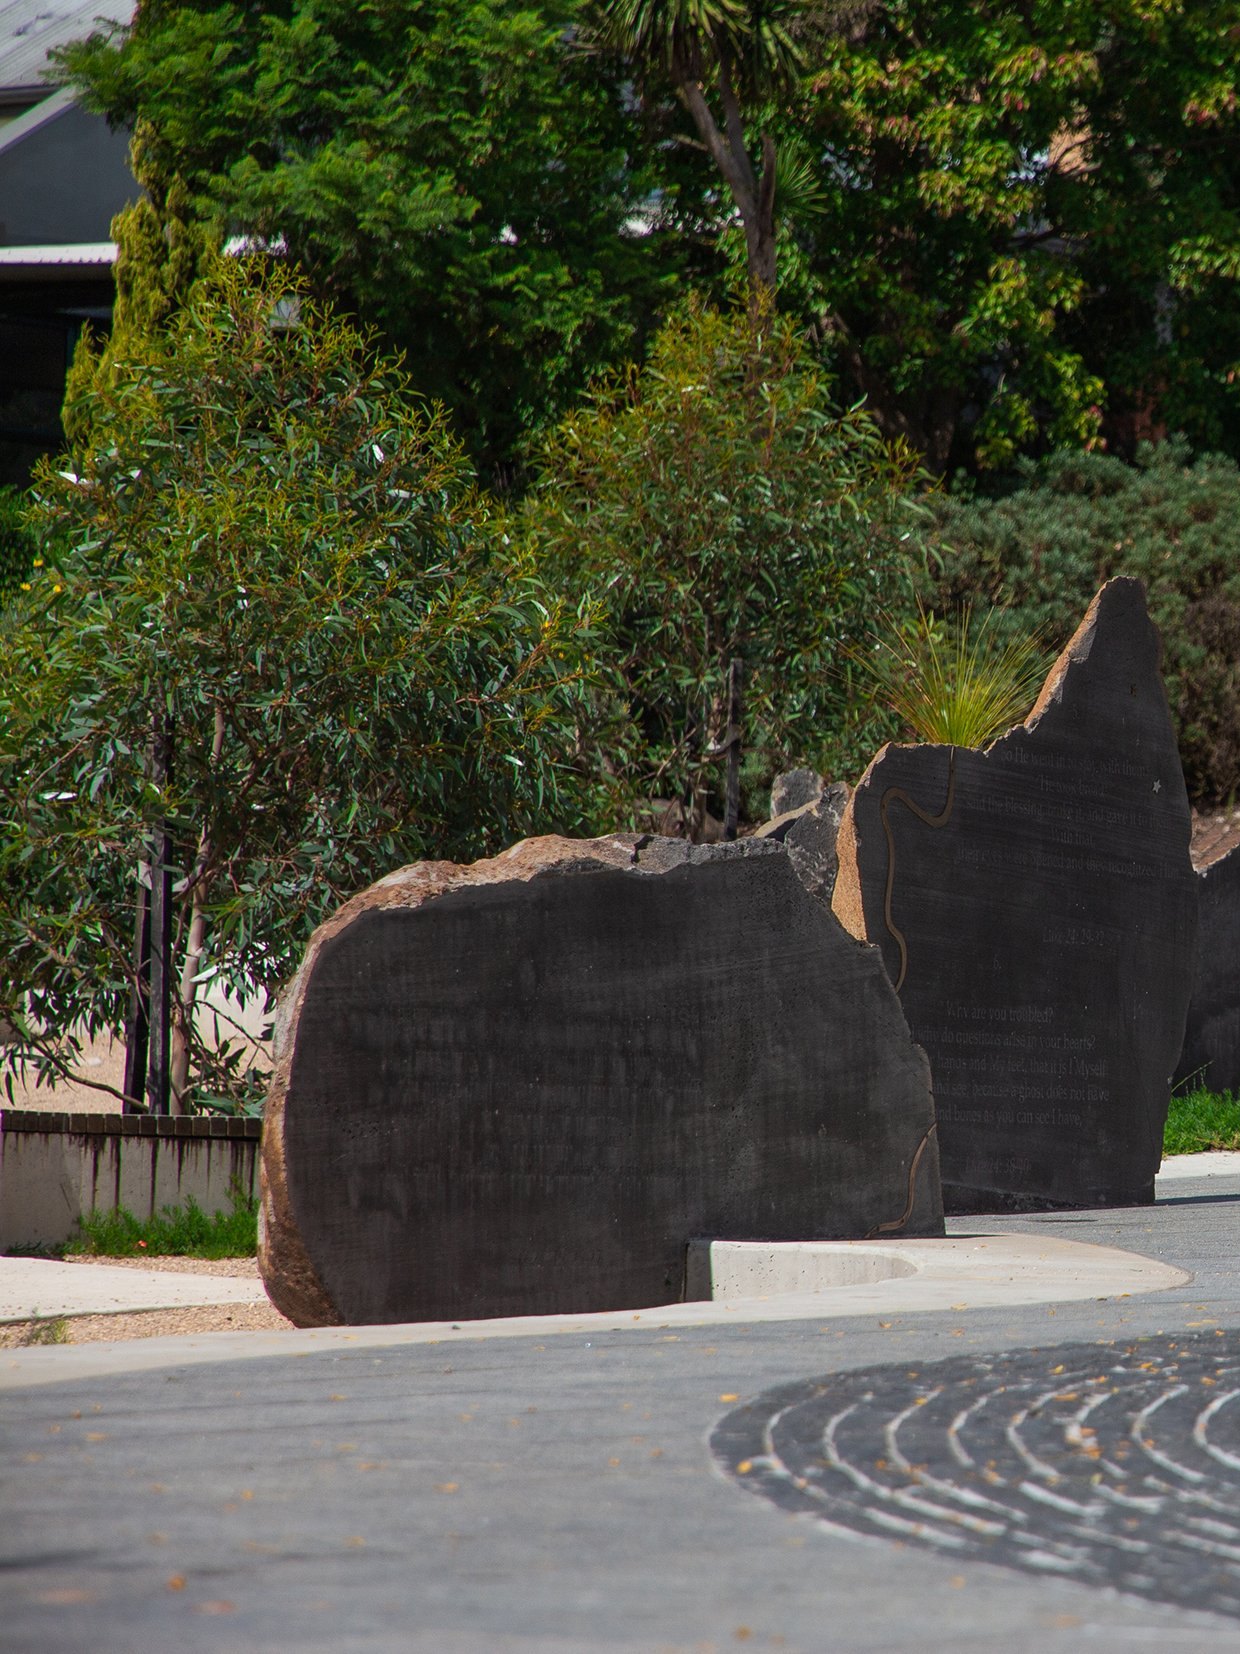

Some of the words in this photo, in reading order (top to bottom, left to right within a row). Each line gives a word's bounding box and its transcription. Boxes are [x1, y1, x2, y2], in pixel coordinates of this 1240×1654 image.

[1015, 746, 1029, 764] He
[971, 1006, 986, 1020] are
[989, 1006, 1007, 1024] you
[941, 1026, 954, 1043] do
[956, 1030, 1001, 1047] questions
[1040, 1036, 1061, 1052] your
[968, 1054, 986, 1071] and
[972, 1079, 1009, 1101] because
[1018, 1080, 1044, 1103] ghost
[1046, 1082, 1068, 1100] does
[1069, 1085, 1085, 1101] not
[1087, 1083, 1110, 1101] have
[954, 1104, 982, 1122] bones
[984, 1108, 994, 1122] as
[996, 1109, 1015, 1127] you
[1016, 1110, 1033, 1124] can
[1035, 1110, 1050, 1125] see
